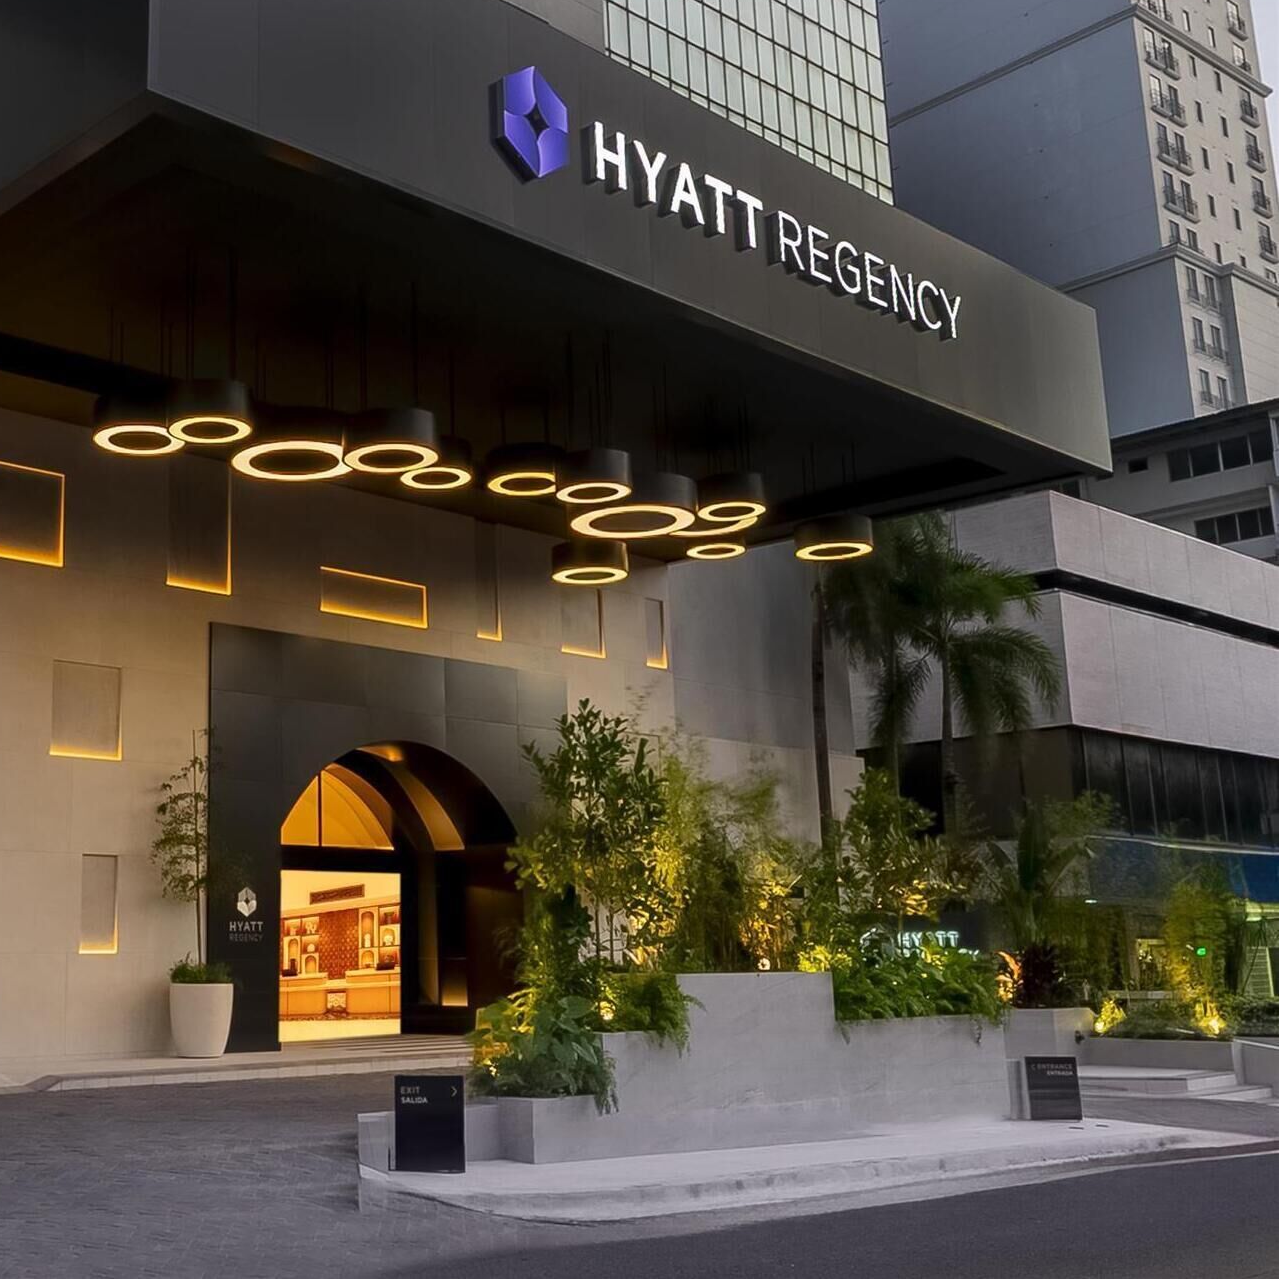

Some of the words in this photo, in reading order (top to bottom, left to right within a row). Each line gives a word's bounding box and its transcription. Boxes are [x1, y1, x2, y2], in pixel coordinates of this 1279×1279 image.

[593, 121, 763, 249] HYATT
[777, 210, 962, 340] REGENCY
[229, 921, 264, 932] HYATT
[228, 932, 264, 942] REGENCY
[400, 1086, 420, 1095] EXIT
[400, 1096, 428, 1104] SALIDA
